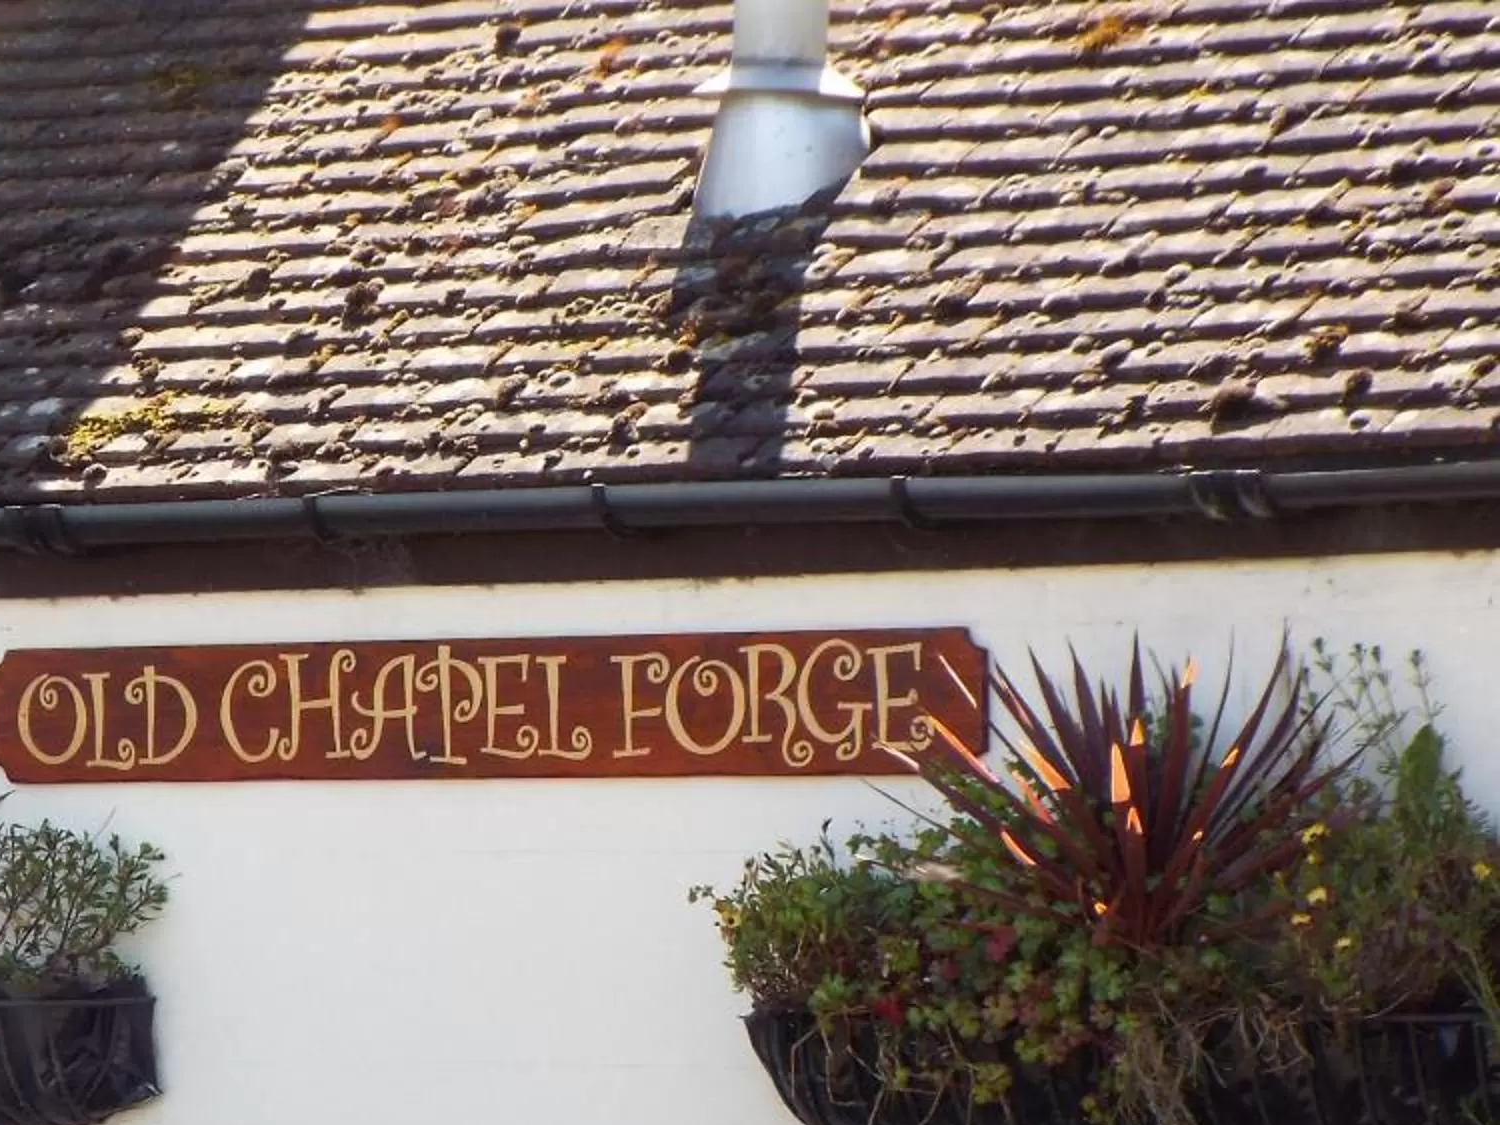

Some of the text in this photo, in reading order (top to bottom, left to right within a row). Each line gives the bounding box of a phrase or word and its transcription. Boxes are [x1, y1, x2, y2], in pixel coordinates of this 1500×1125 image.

[16, 638, 936, 772] OLD CHAPEL FORGE
